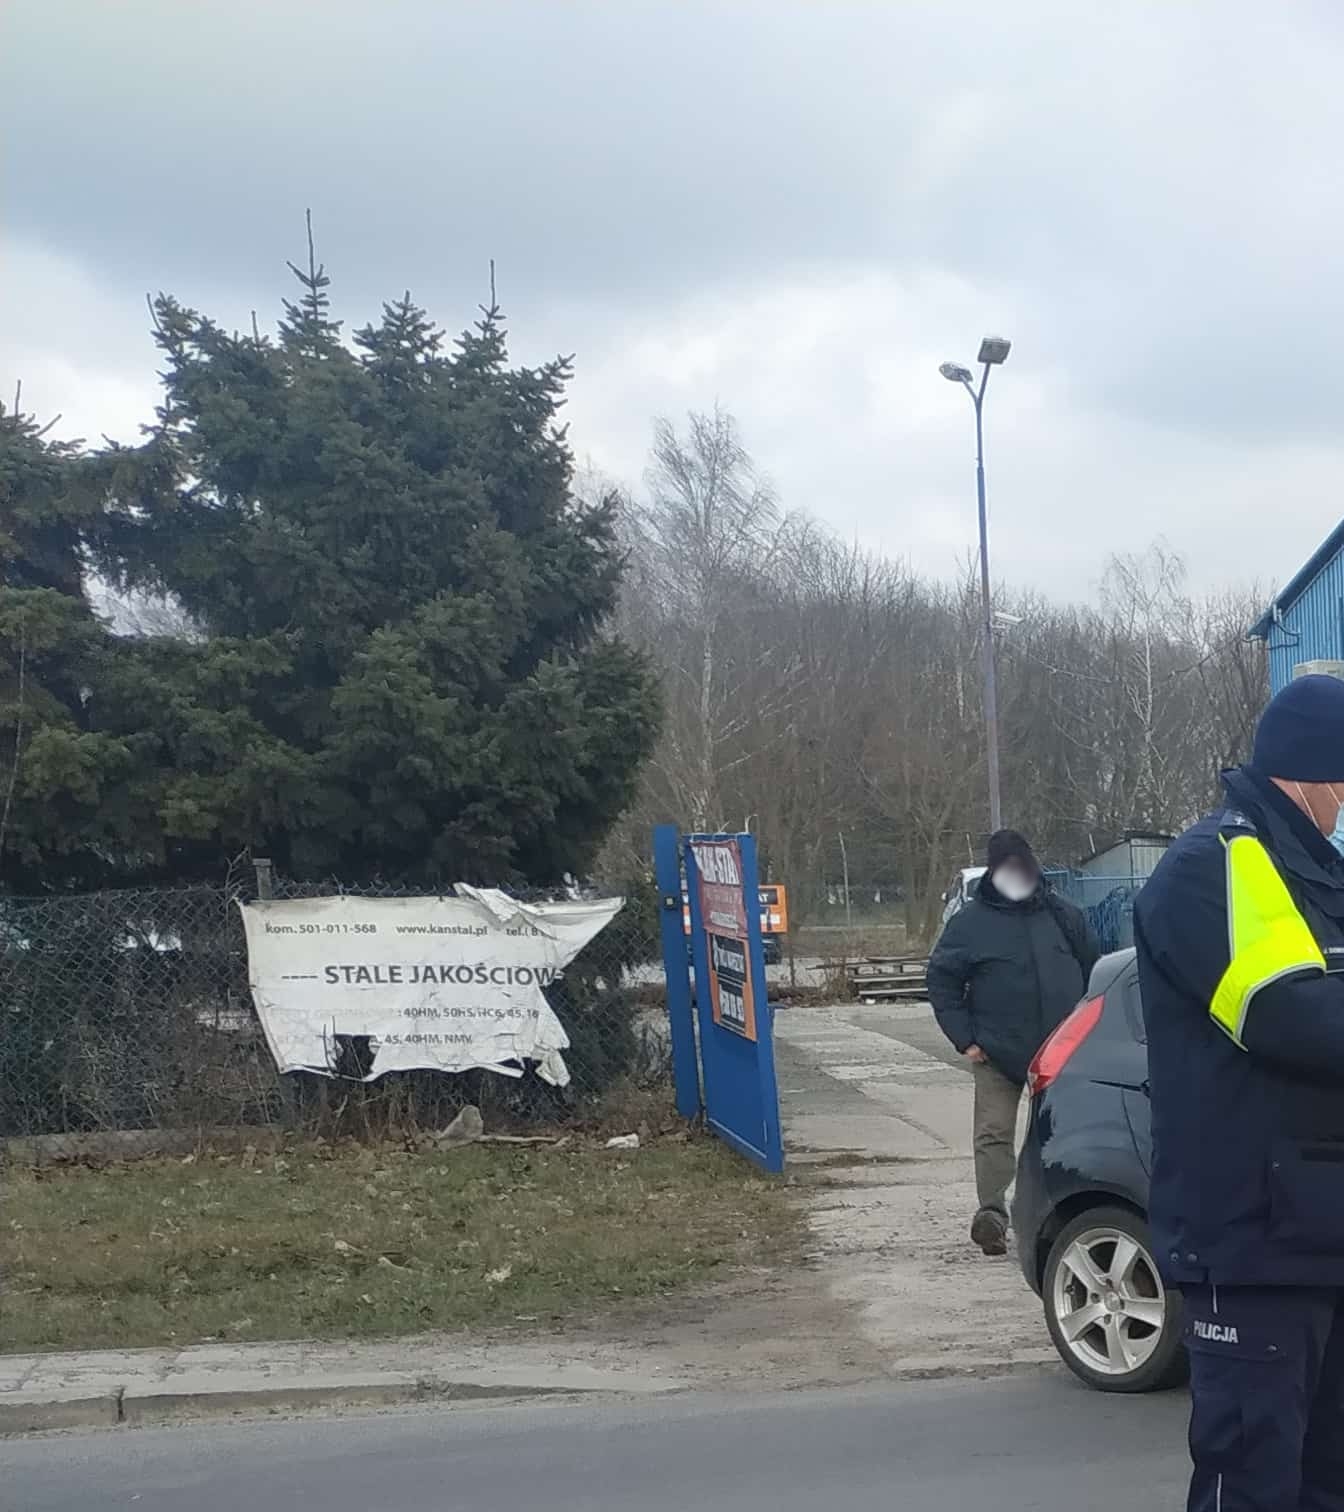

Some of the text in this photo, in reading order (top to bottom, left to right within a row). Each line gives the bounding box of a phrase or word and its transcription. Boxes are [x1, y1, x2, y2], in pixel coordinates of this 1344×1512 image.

[265, 922, 298, 934] kom.
[299, 924, 377, 934] 501-011-568
[395, 923, 488, 937] www.kanstal.pl
[324, 965, 403, 985] STALE
[1194, 1320, 1239, 1344] POLICJA
